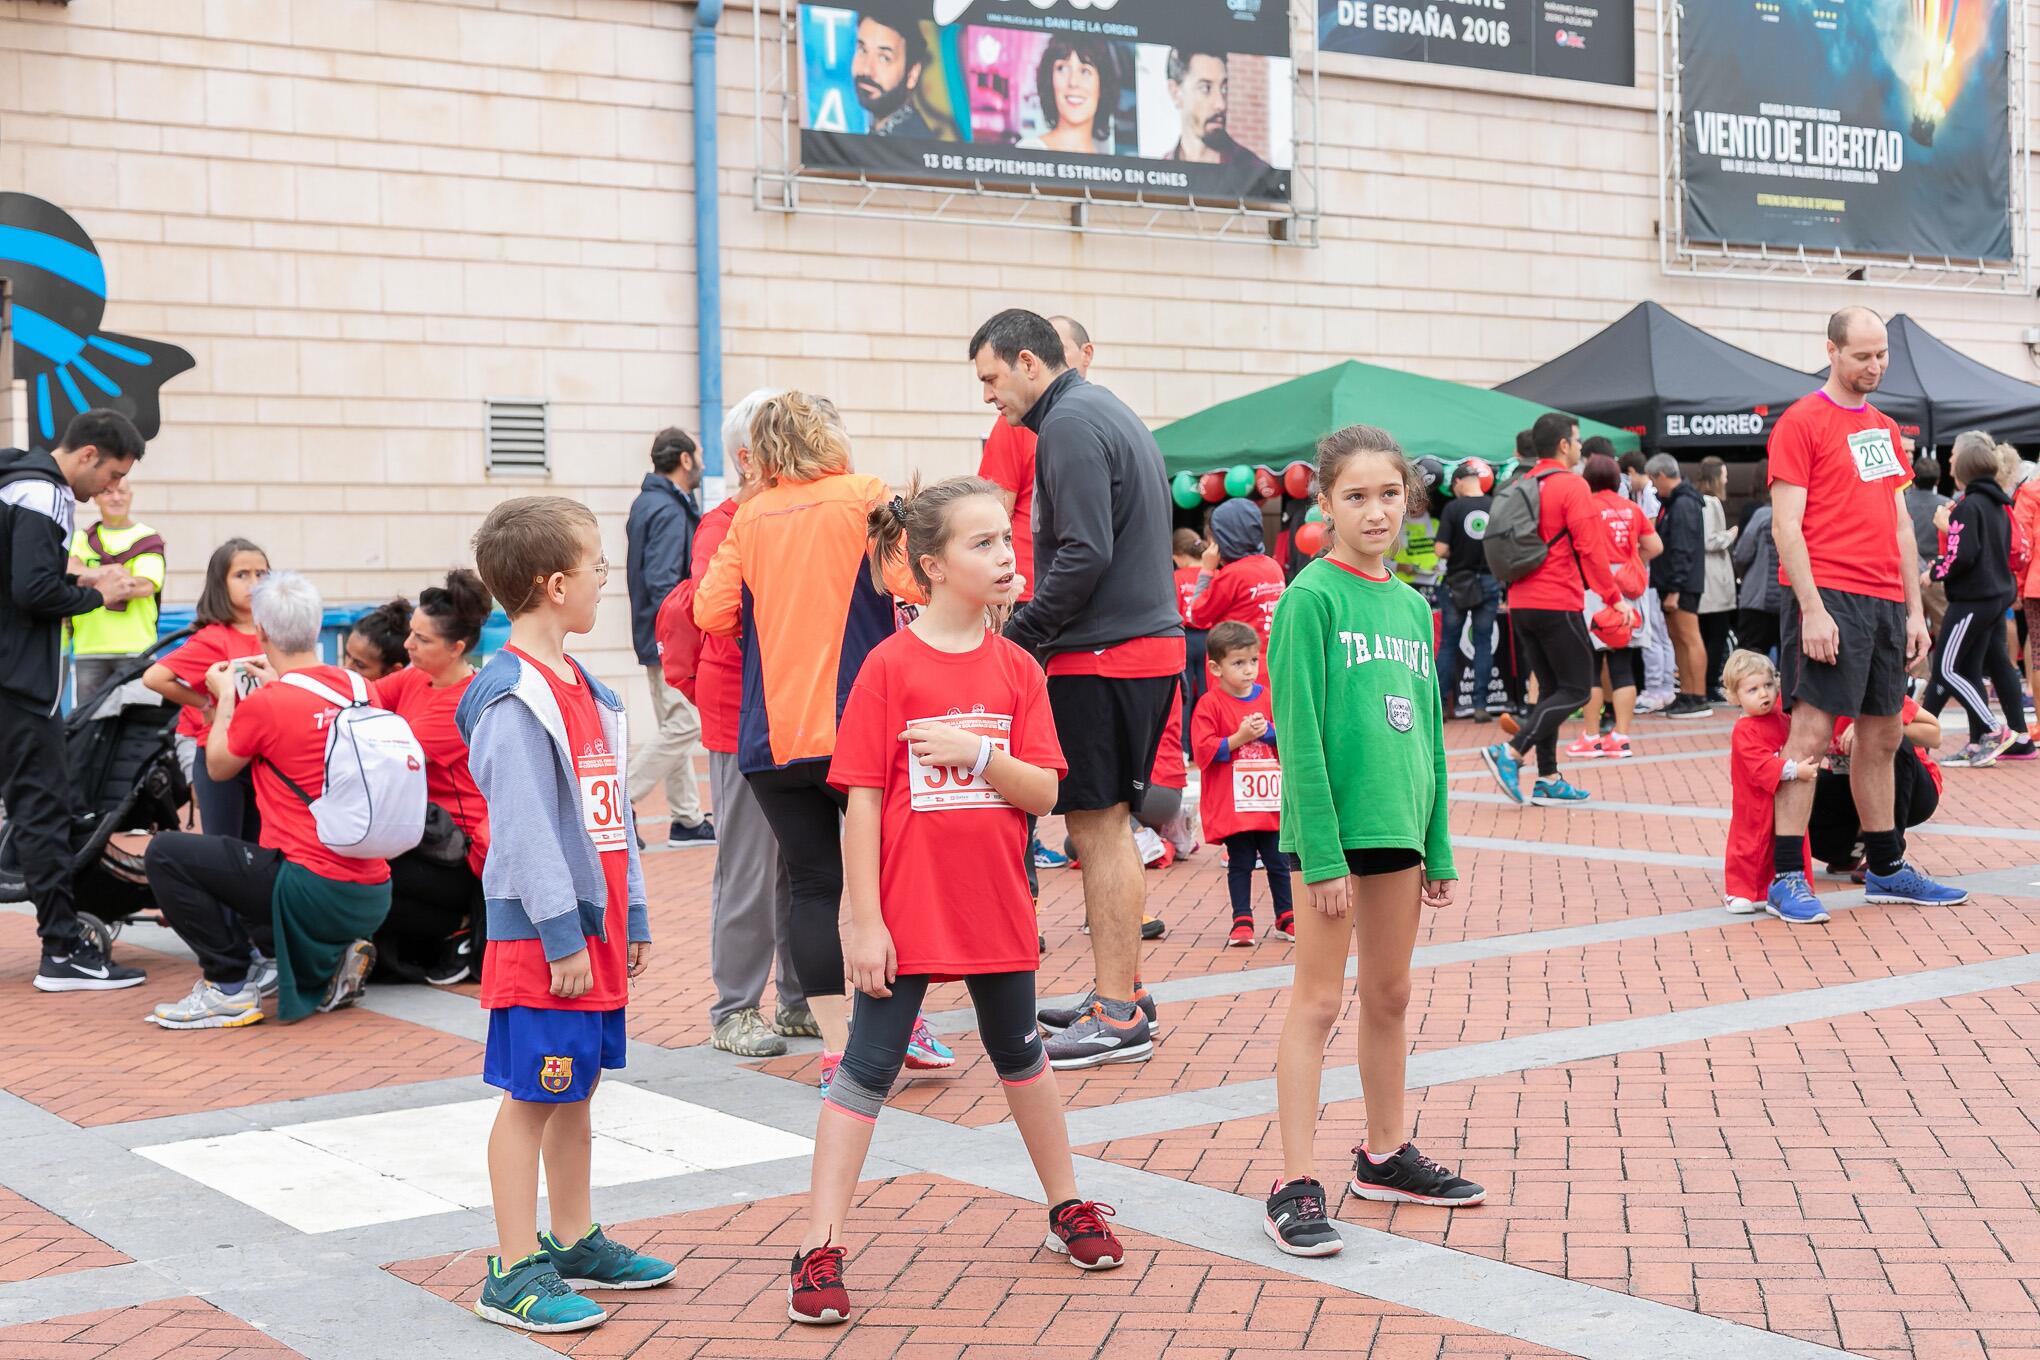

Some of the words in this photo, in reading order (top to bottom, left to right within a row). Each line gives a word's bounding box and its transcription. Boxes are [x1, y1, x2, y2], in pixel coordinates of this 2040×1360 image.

[1044, 16, 1071, 30] DANI
[1071, 19, 1087, 32] DE
[1087, 21, 1102, 33] LA
[1102, 22, 1138, 37] ORDEN
[1338, 0, 1368, 28] DE
[1373, 4, 1457, 40] ESPAÑA
[1461, 16, 1511, 47] 2016
[1694, 110, 1772, 160] VIENTO
[1774, 118, 1804, 163] DE
[1805, 121, 1903, 173] LIBERTAD
[923, 153, 940, 169] 13
[942, 155, 964, 170] DE
[966, 157, 1056, 178] SEPTIEMBRE
[1057, 163, 1123, 183] ESTRENO
[1124, 169, 1145, 184] EN
[1146, 170, 1188, 188] CINES
[1666, 414, 1690, 435] EL
[1690, 413, 1764, 435] CORREO
[1860, 442, 1892, 467] 201
[1338, 631, 1430, 678] TRAINING
[1242, 774, 1281, 798] 300
